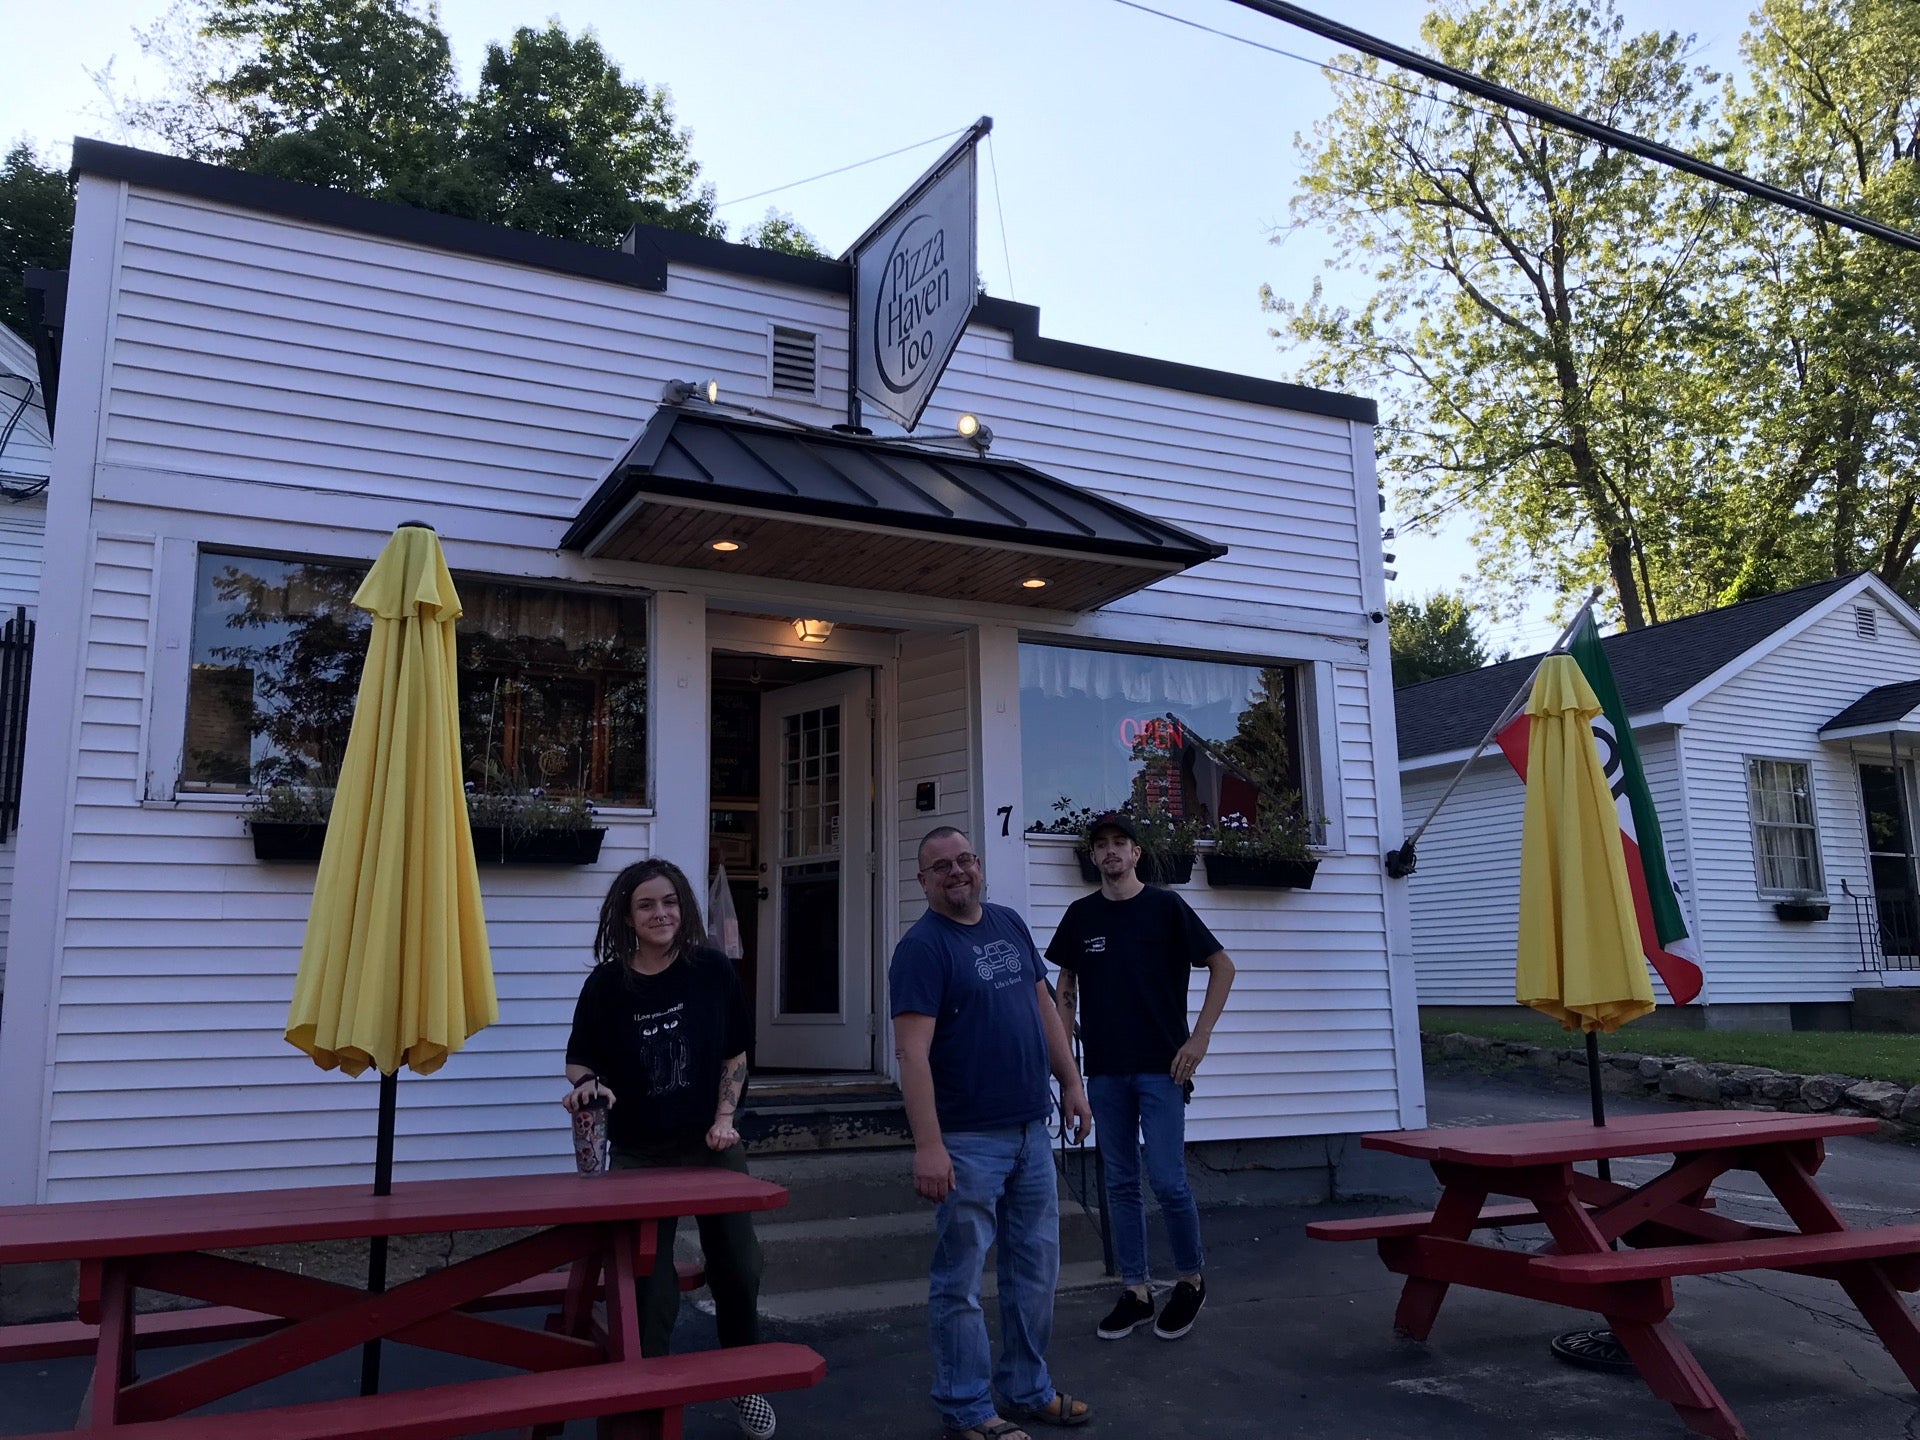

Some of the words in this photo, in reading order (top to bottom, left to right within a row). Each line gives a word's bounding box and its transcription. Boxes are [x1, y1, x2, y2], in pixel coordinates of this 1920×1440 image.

[892, 228, 944, 303] Pizza
[888, 268, 949, 347] Haven
[897, 329, 933, 377] Too
[1120, 718, 1183, 749] OPEN
[996, 805, 1013, 837] 7
